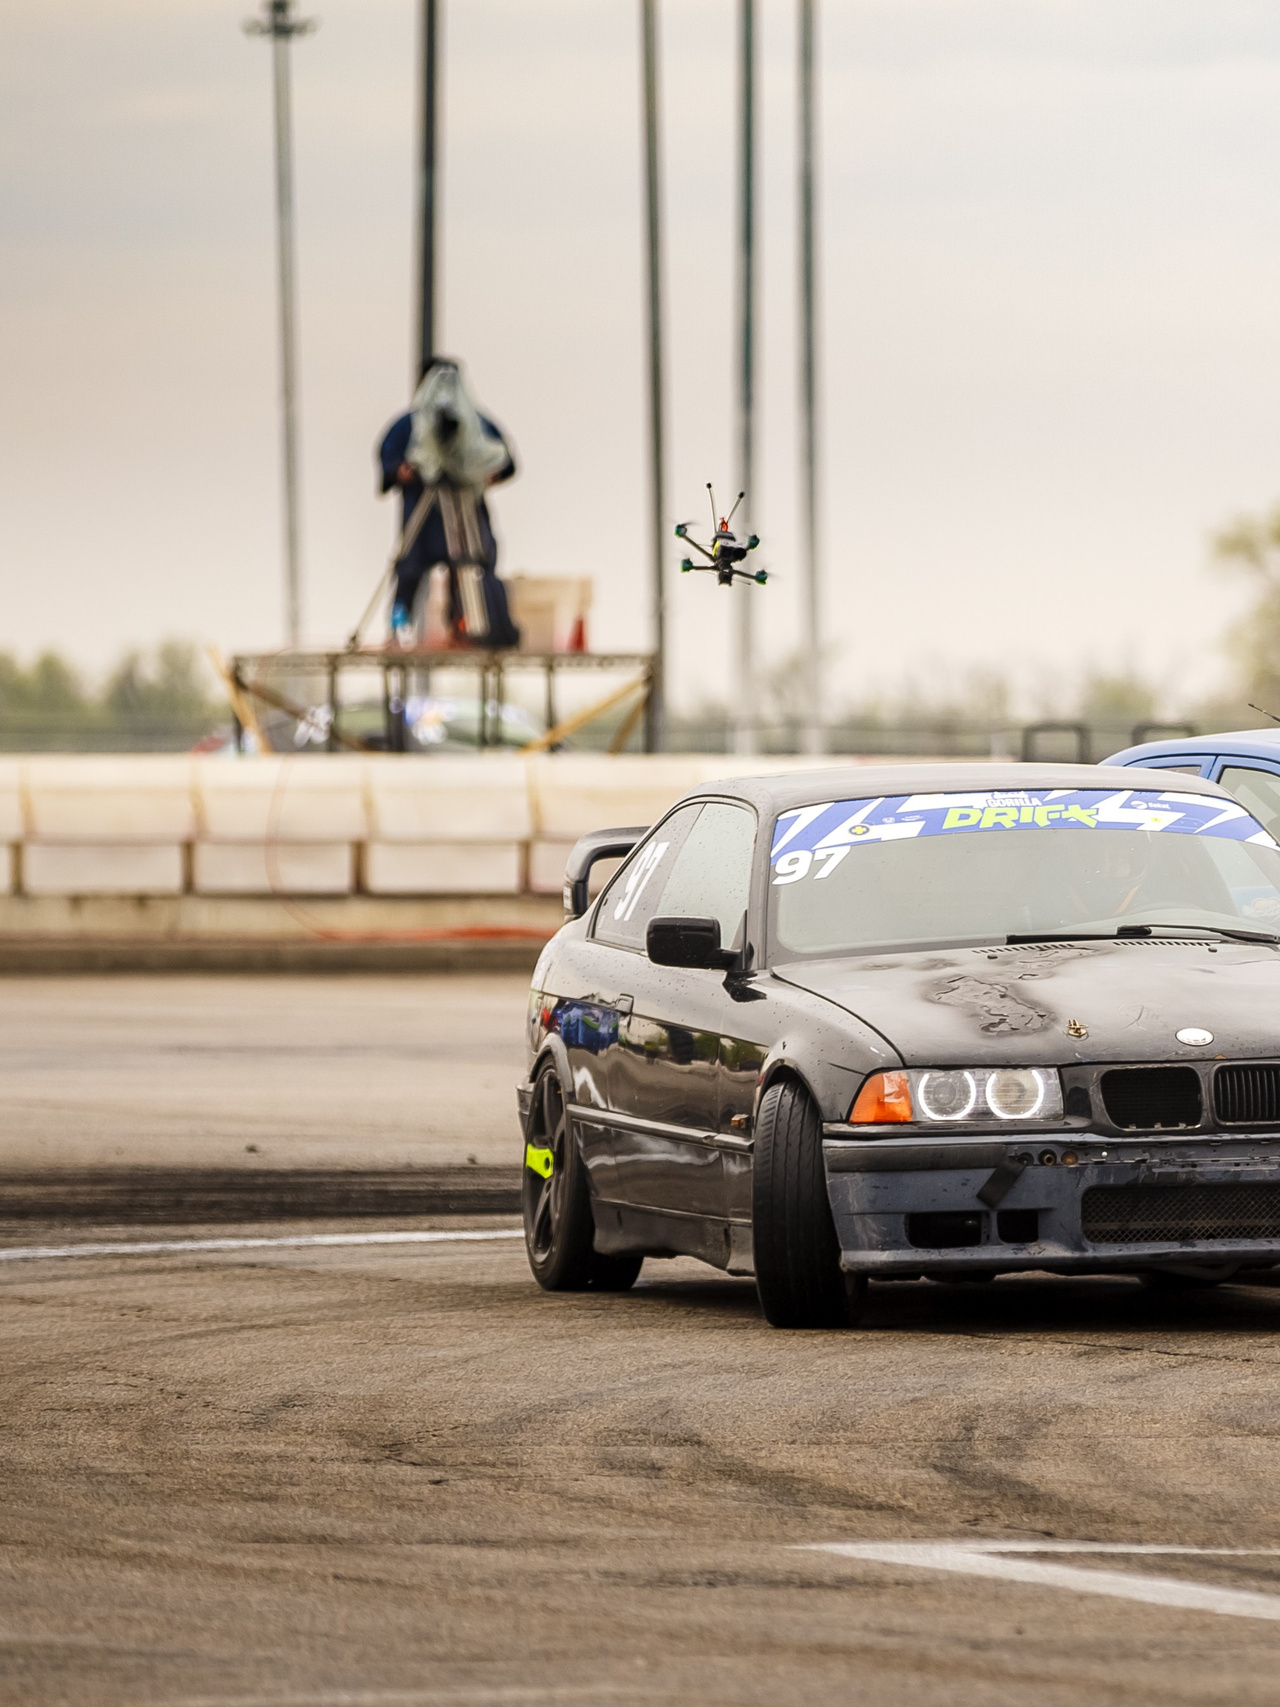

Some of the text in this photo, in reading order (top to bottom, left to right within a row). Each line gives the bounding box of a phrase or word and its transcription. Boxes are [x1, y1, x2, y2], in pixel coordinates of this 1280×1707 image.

[942, 804, 1099, 830] DRIFT
[986, 798, 1043, 808] GORILLA
[613, 841, 671, 922] 97
[771, 846, 851, 885] 97
